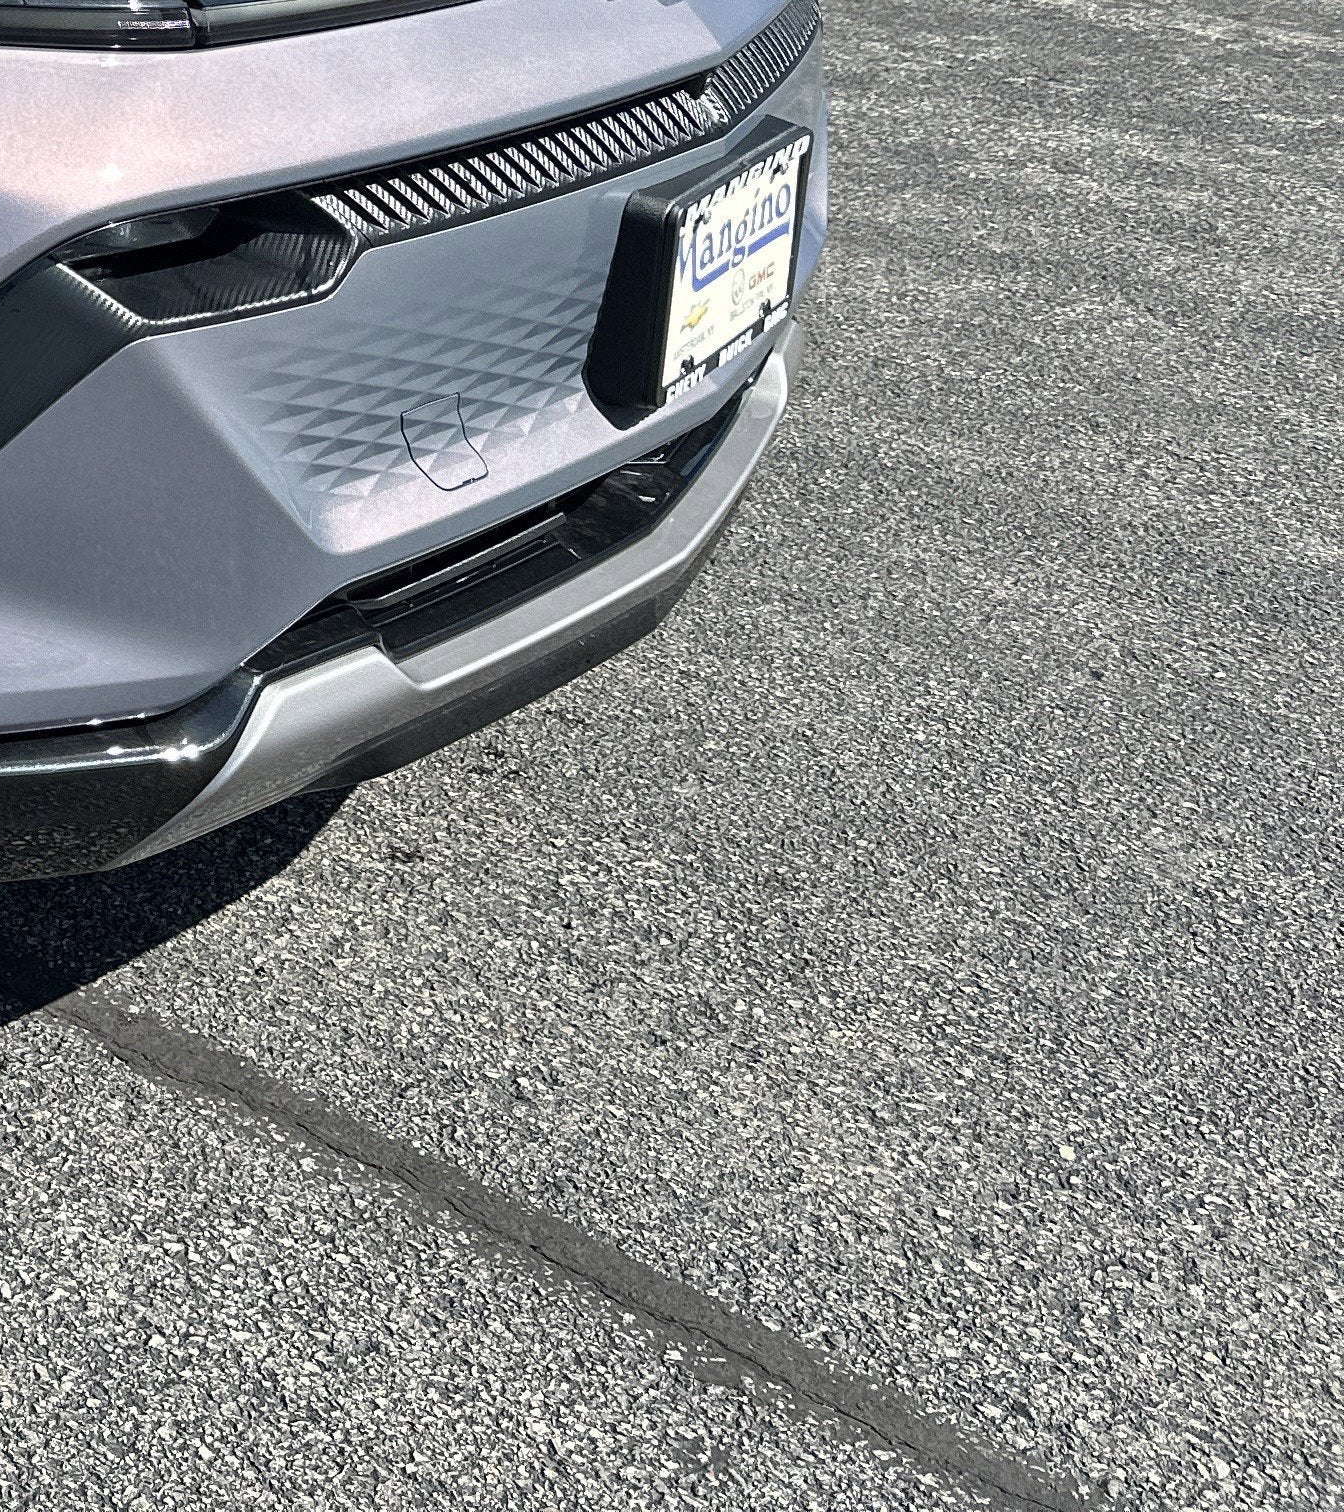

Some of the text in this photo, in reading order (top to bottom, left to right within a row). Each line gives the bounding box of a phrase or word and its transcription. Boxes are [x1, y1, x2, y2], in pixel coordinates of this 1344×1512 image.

[748, 261, 776, 291] GMC
[665, 363, 708, 407] CHEVY
[718, 328, 754, 368] BUICK
